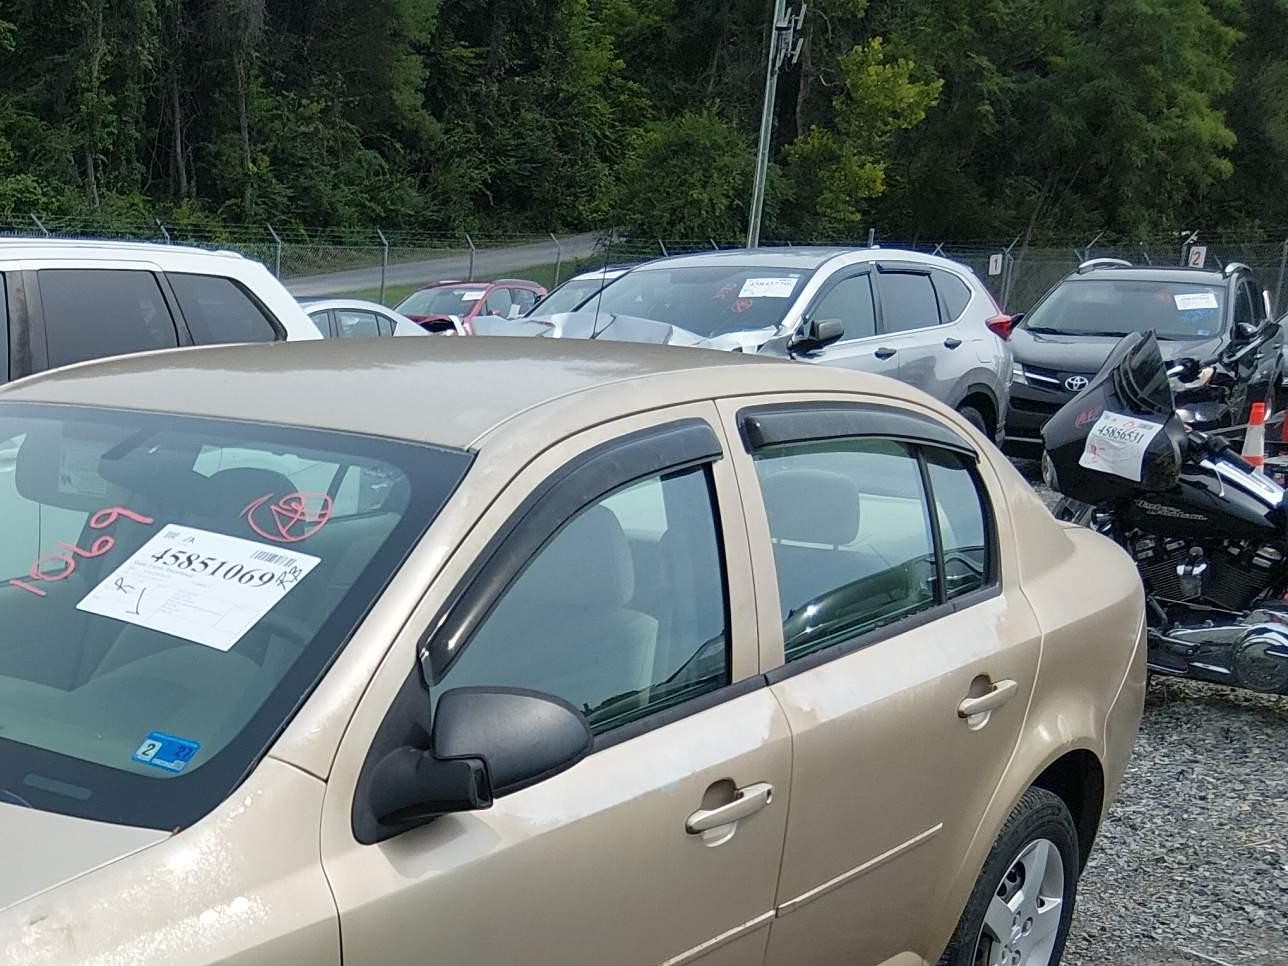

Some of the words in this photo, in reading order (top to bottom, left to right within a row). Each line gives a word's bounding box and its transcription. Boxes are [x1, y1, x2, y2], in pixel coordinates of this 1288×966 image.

[1192, 251, 1201, 266] 2
[9, 505, 155, 598] 1069
[151, 547, 276, 588] 45851069
[141, 743, 156, 757] 2
[174, 745, 194, 759] 27
